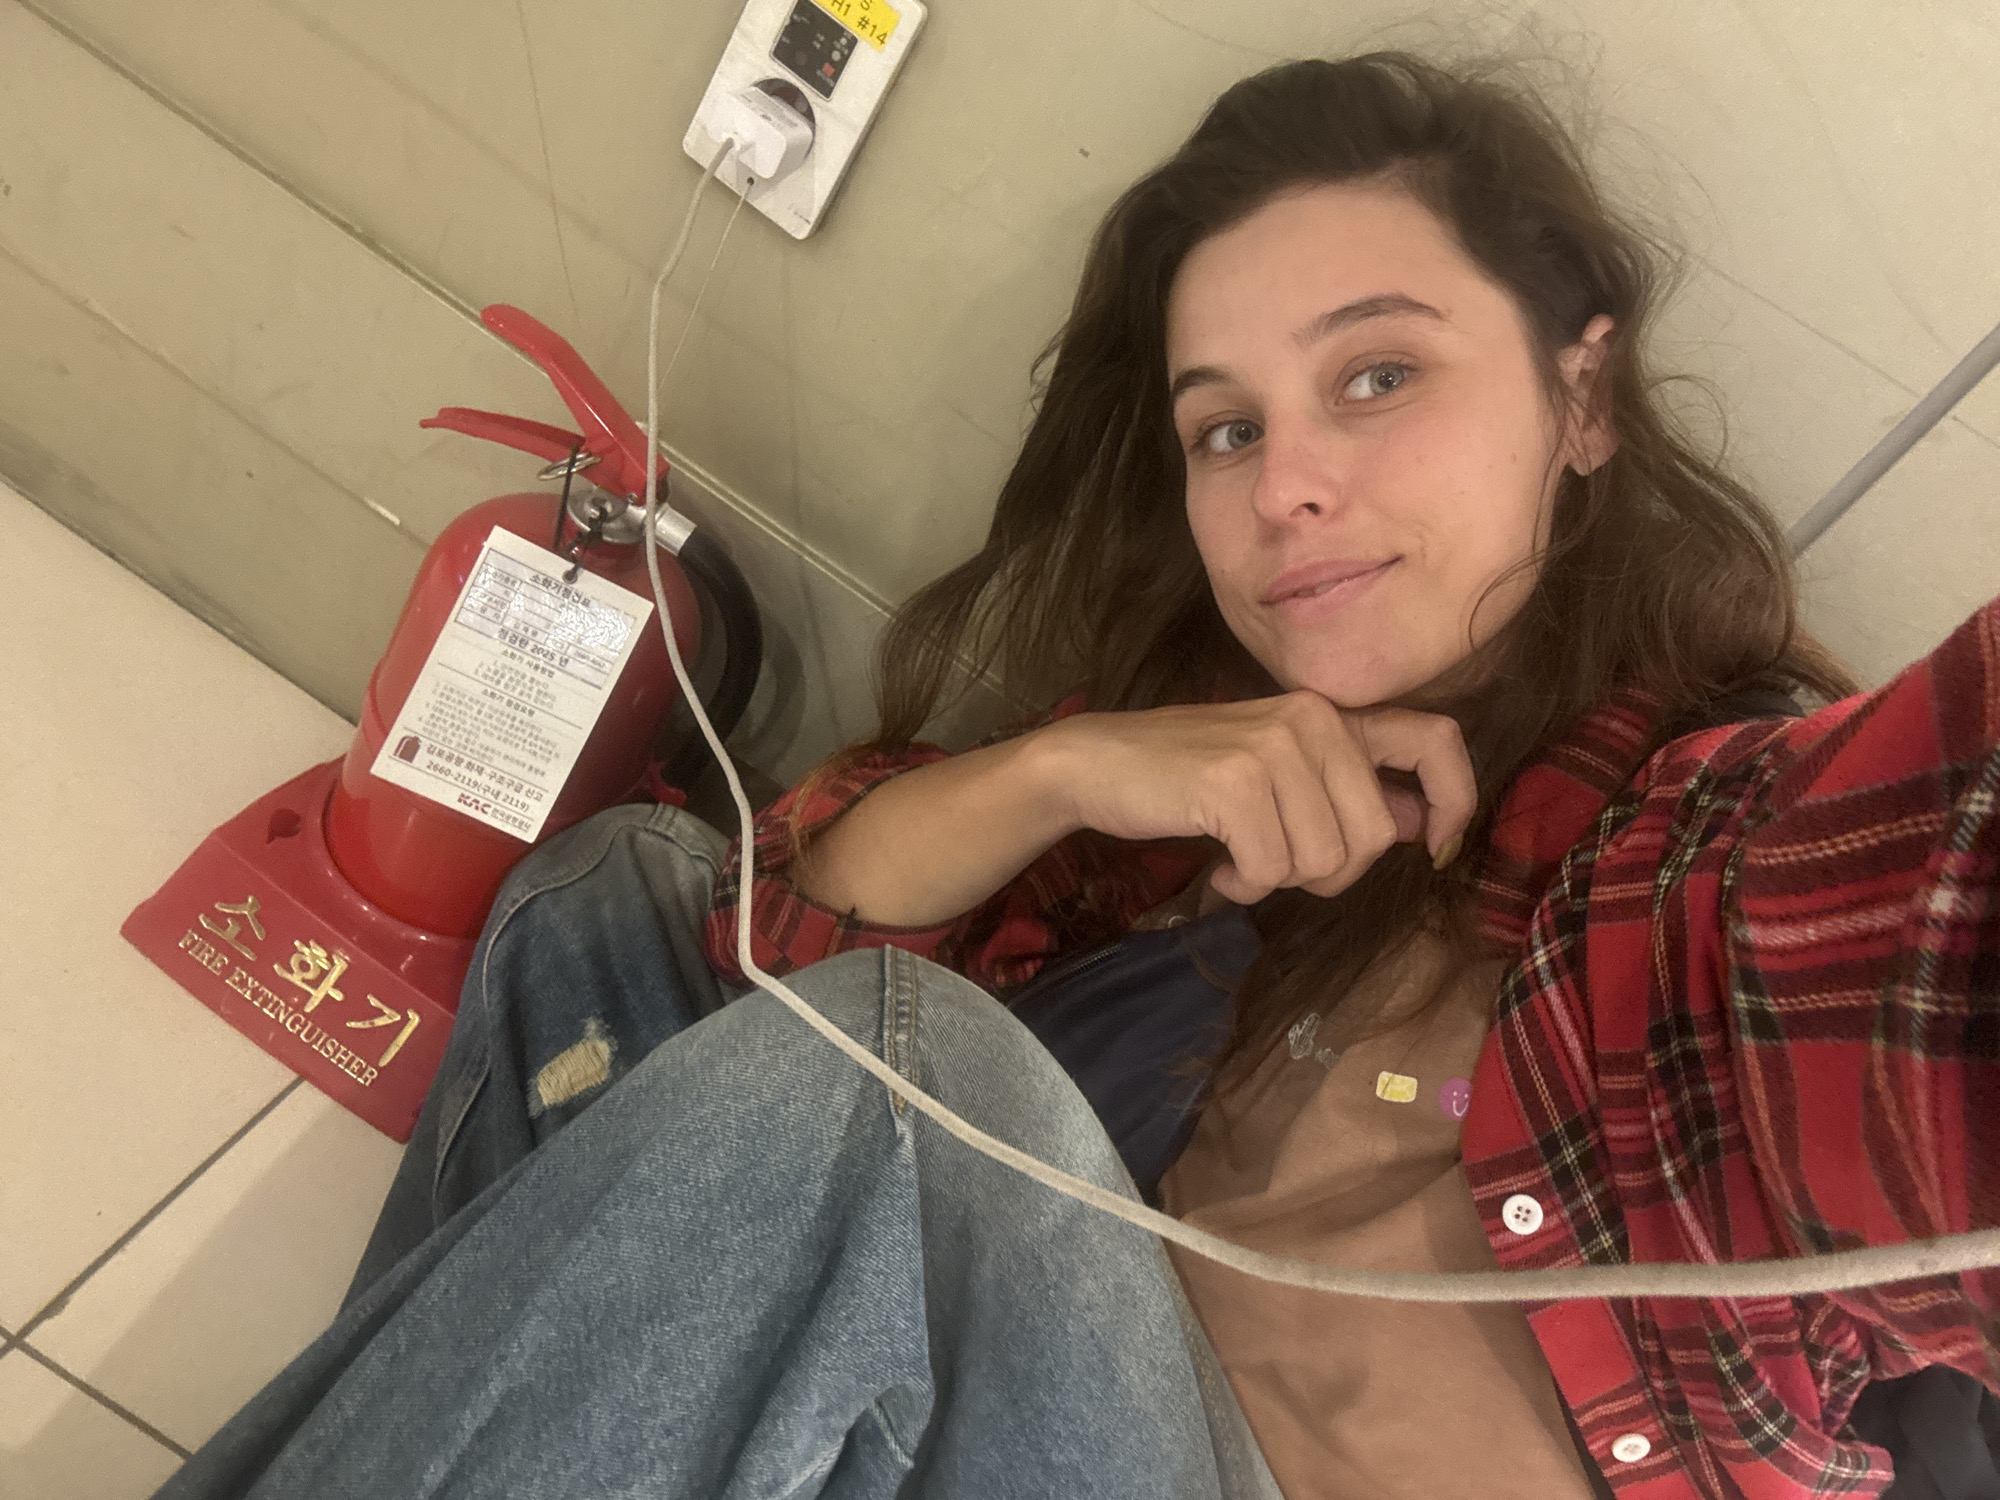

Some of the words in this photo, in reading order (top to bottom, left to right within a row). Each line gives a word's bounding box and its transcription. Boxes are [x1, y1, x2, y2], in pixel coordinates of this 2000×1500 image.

[857, 15, 888, 46] #14
[529, 643, 556, 662] 2025
[557, 655, 569, 668] 년
[425, 743, 465, 768] 김포공항
[524, 786, 543, 802] 신고
[425, 758, 501, 801] 2660-2119(구내
[501, 792, 530, 812] 2119)
[456, 791, 491, 815] KAC
[178, 929, 228, 974] FIRE
[226, 965, 379, 1087] EXTINGUISHER
